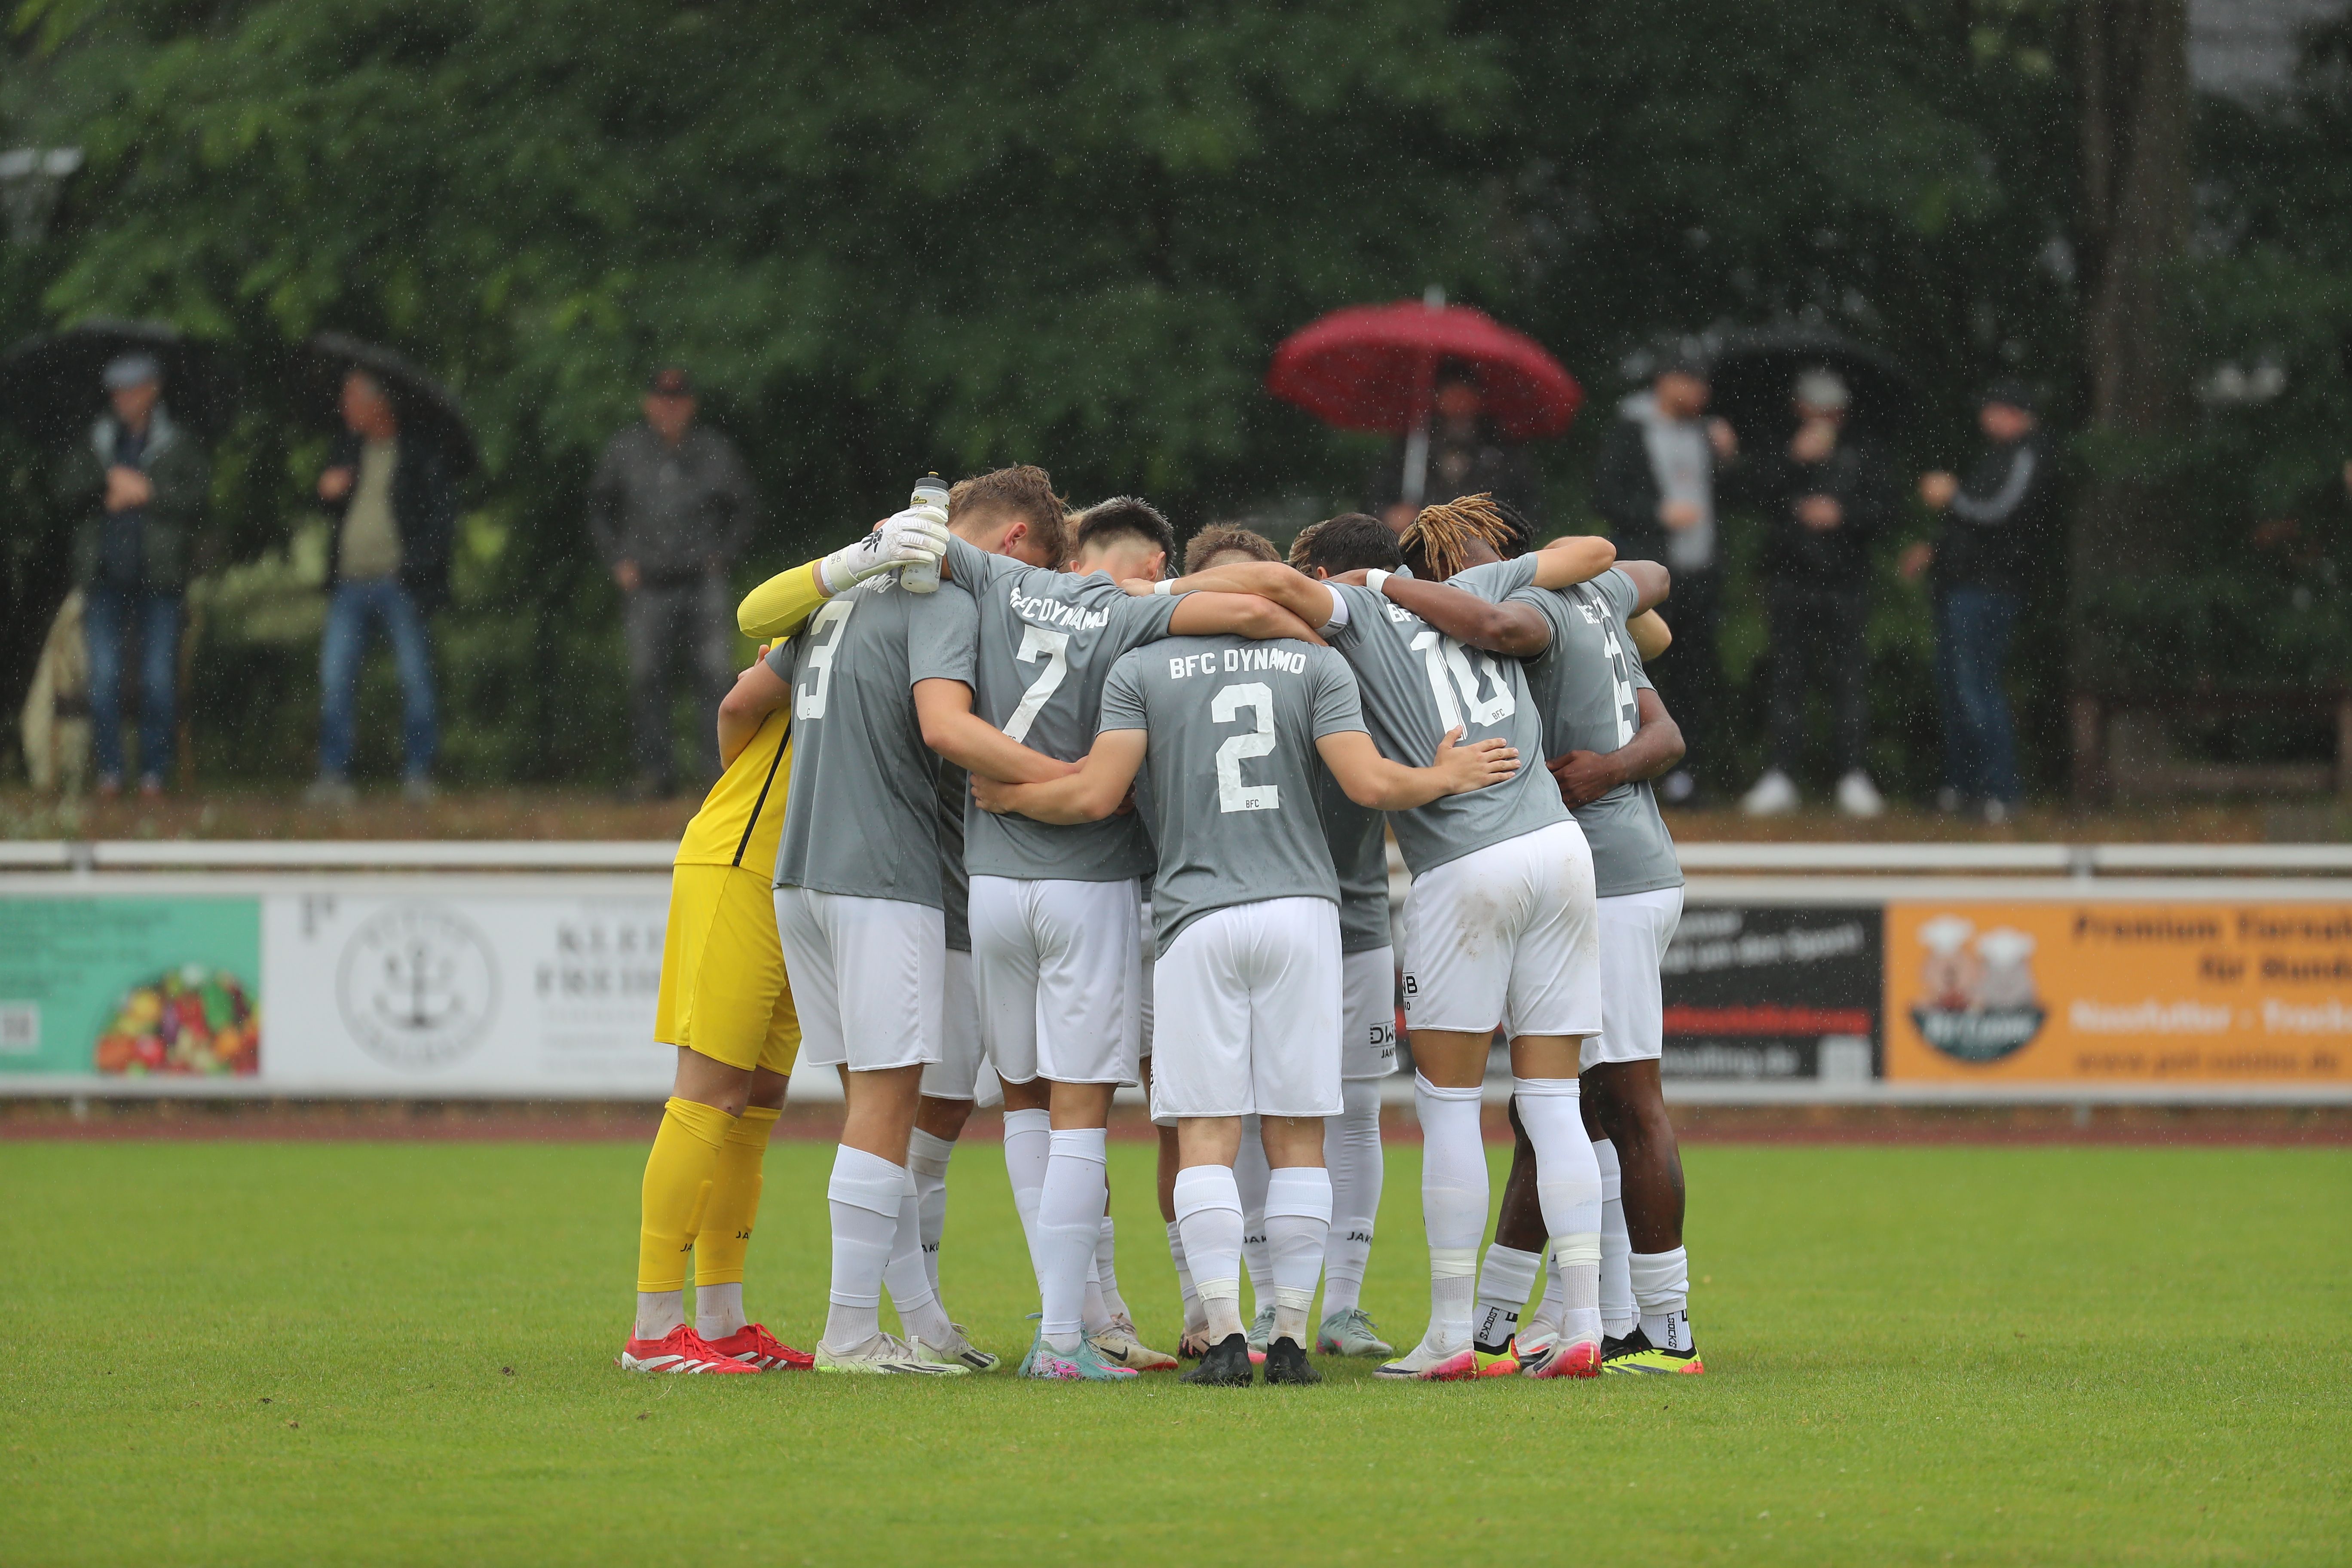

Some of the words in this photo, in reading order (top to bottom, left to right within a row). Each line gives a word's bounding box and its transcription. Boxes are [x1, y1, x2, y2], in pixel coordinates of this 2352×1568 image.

[1038, 598, 1109, 631] DYNAMO
[796, 600, 854, 720] 3
[1169, 652, 1216, 679] BFC
[1224, 648, 1306, 675] DYNAMO
[1002, 624, 1070, 744] 7
[1410, 631, 1516, 741] 10
[1491, 708, 1505, 720] BFC
[1211, 682, 1280, 813] 2
[1246, 799, 1259, 808] BFC
[680, 1243, 692, 1252] JA
[736, 1231, 749, 1240] JA
[922, 1242, 939, 1253] AKO
